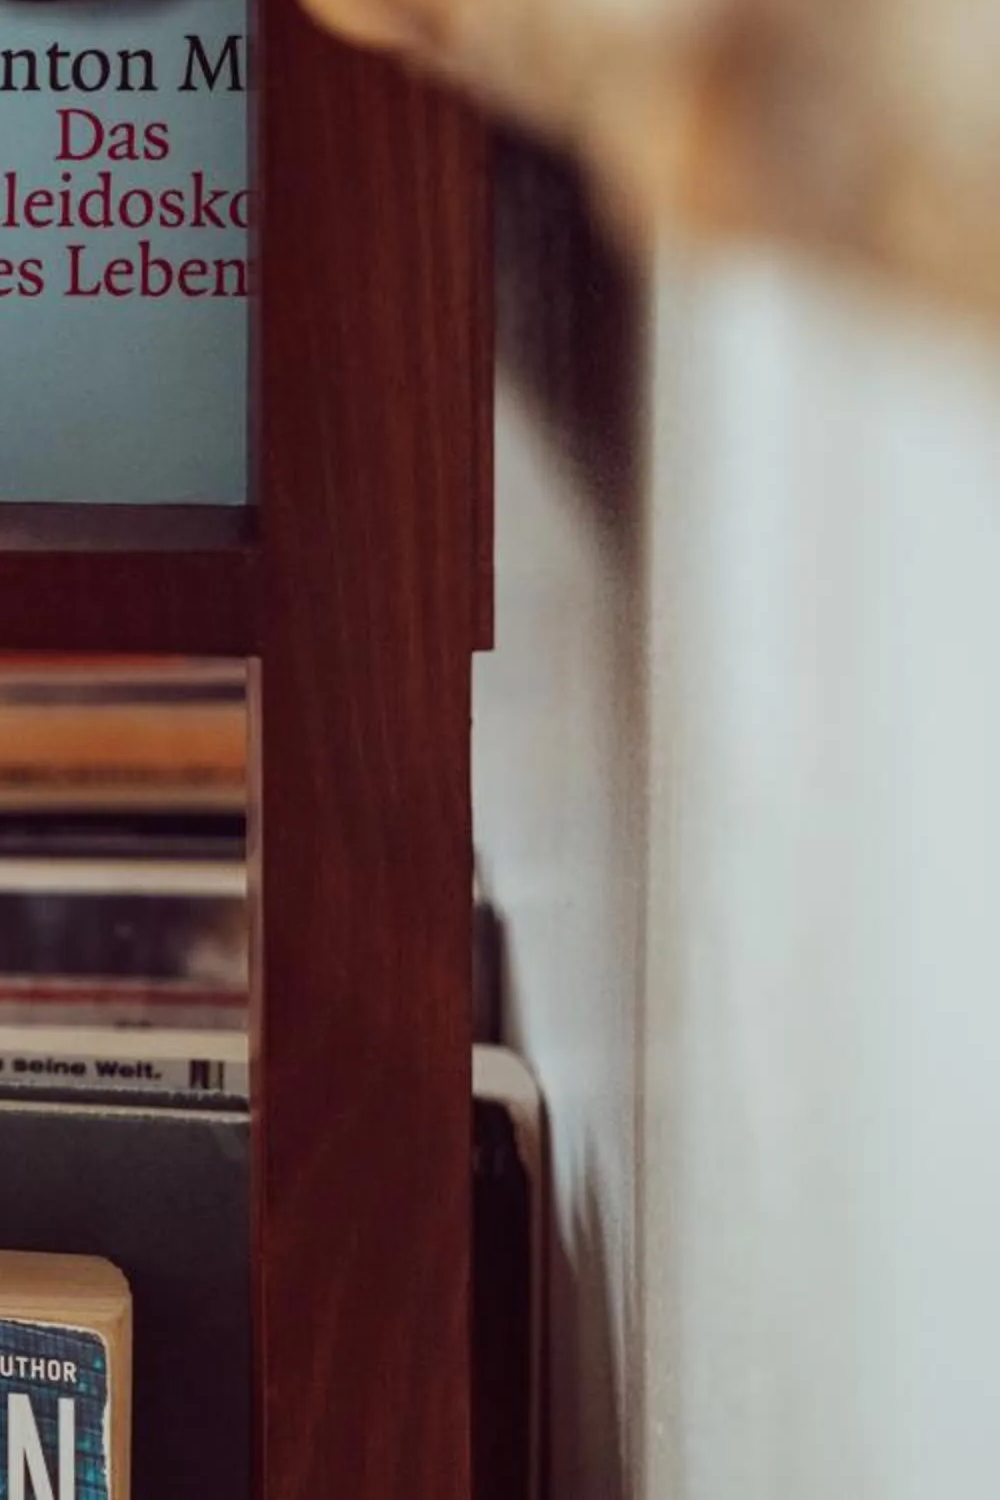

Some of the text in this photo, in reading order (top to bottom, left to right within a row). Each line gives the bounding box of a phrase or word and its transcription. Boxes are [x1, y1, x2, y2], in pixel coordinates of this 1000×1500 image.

[55, 108, 170, 161] Das
[64, 241, 249, 297] Leben
[12, 1056, 87, 1077] seine
[95, 1059, 163, 1081] Welt.
